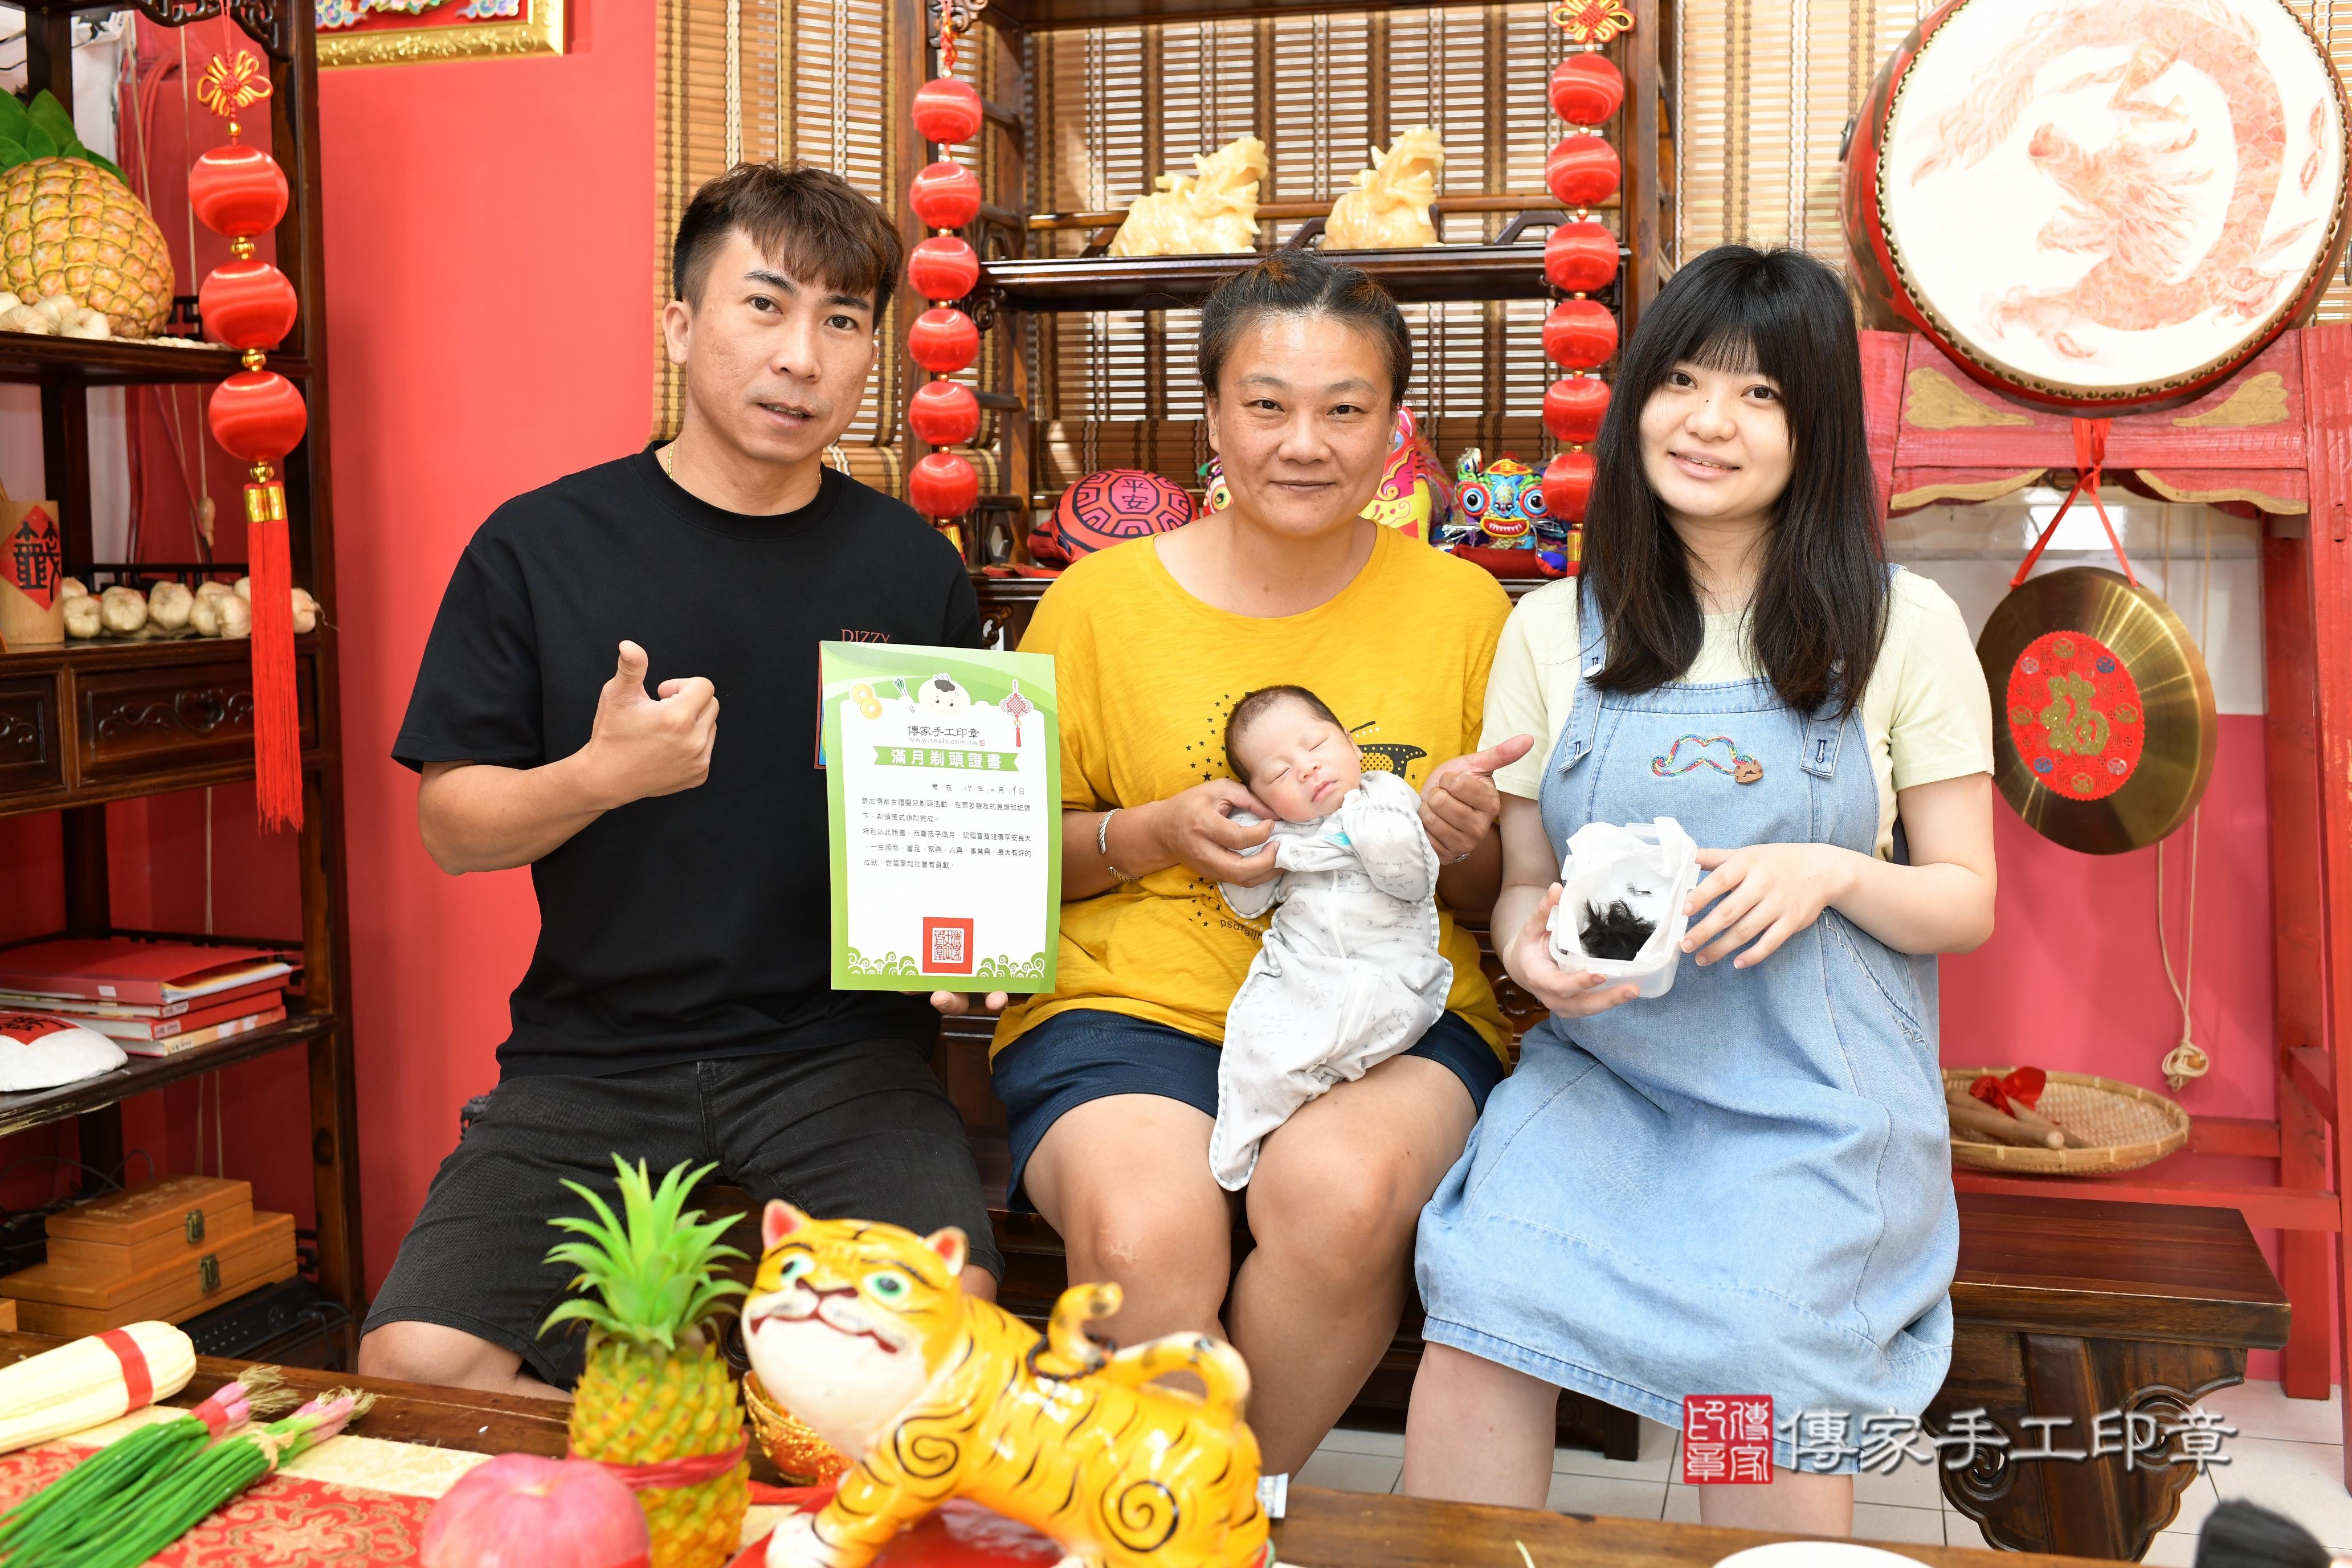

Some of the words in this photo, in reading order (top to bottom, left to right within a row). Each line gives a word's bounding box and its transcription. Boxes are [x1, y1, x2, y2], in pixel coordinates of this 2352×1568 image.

[1121, 479, 1149, 510] 平安
[841, 629, 891, 643] DIZZY
[2040, 671, 2110, 757] 福
[907, 725, 979, 739] 傳家手工印章
[891, 748, 1002, 769] 滿月剃頭證書
